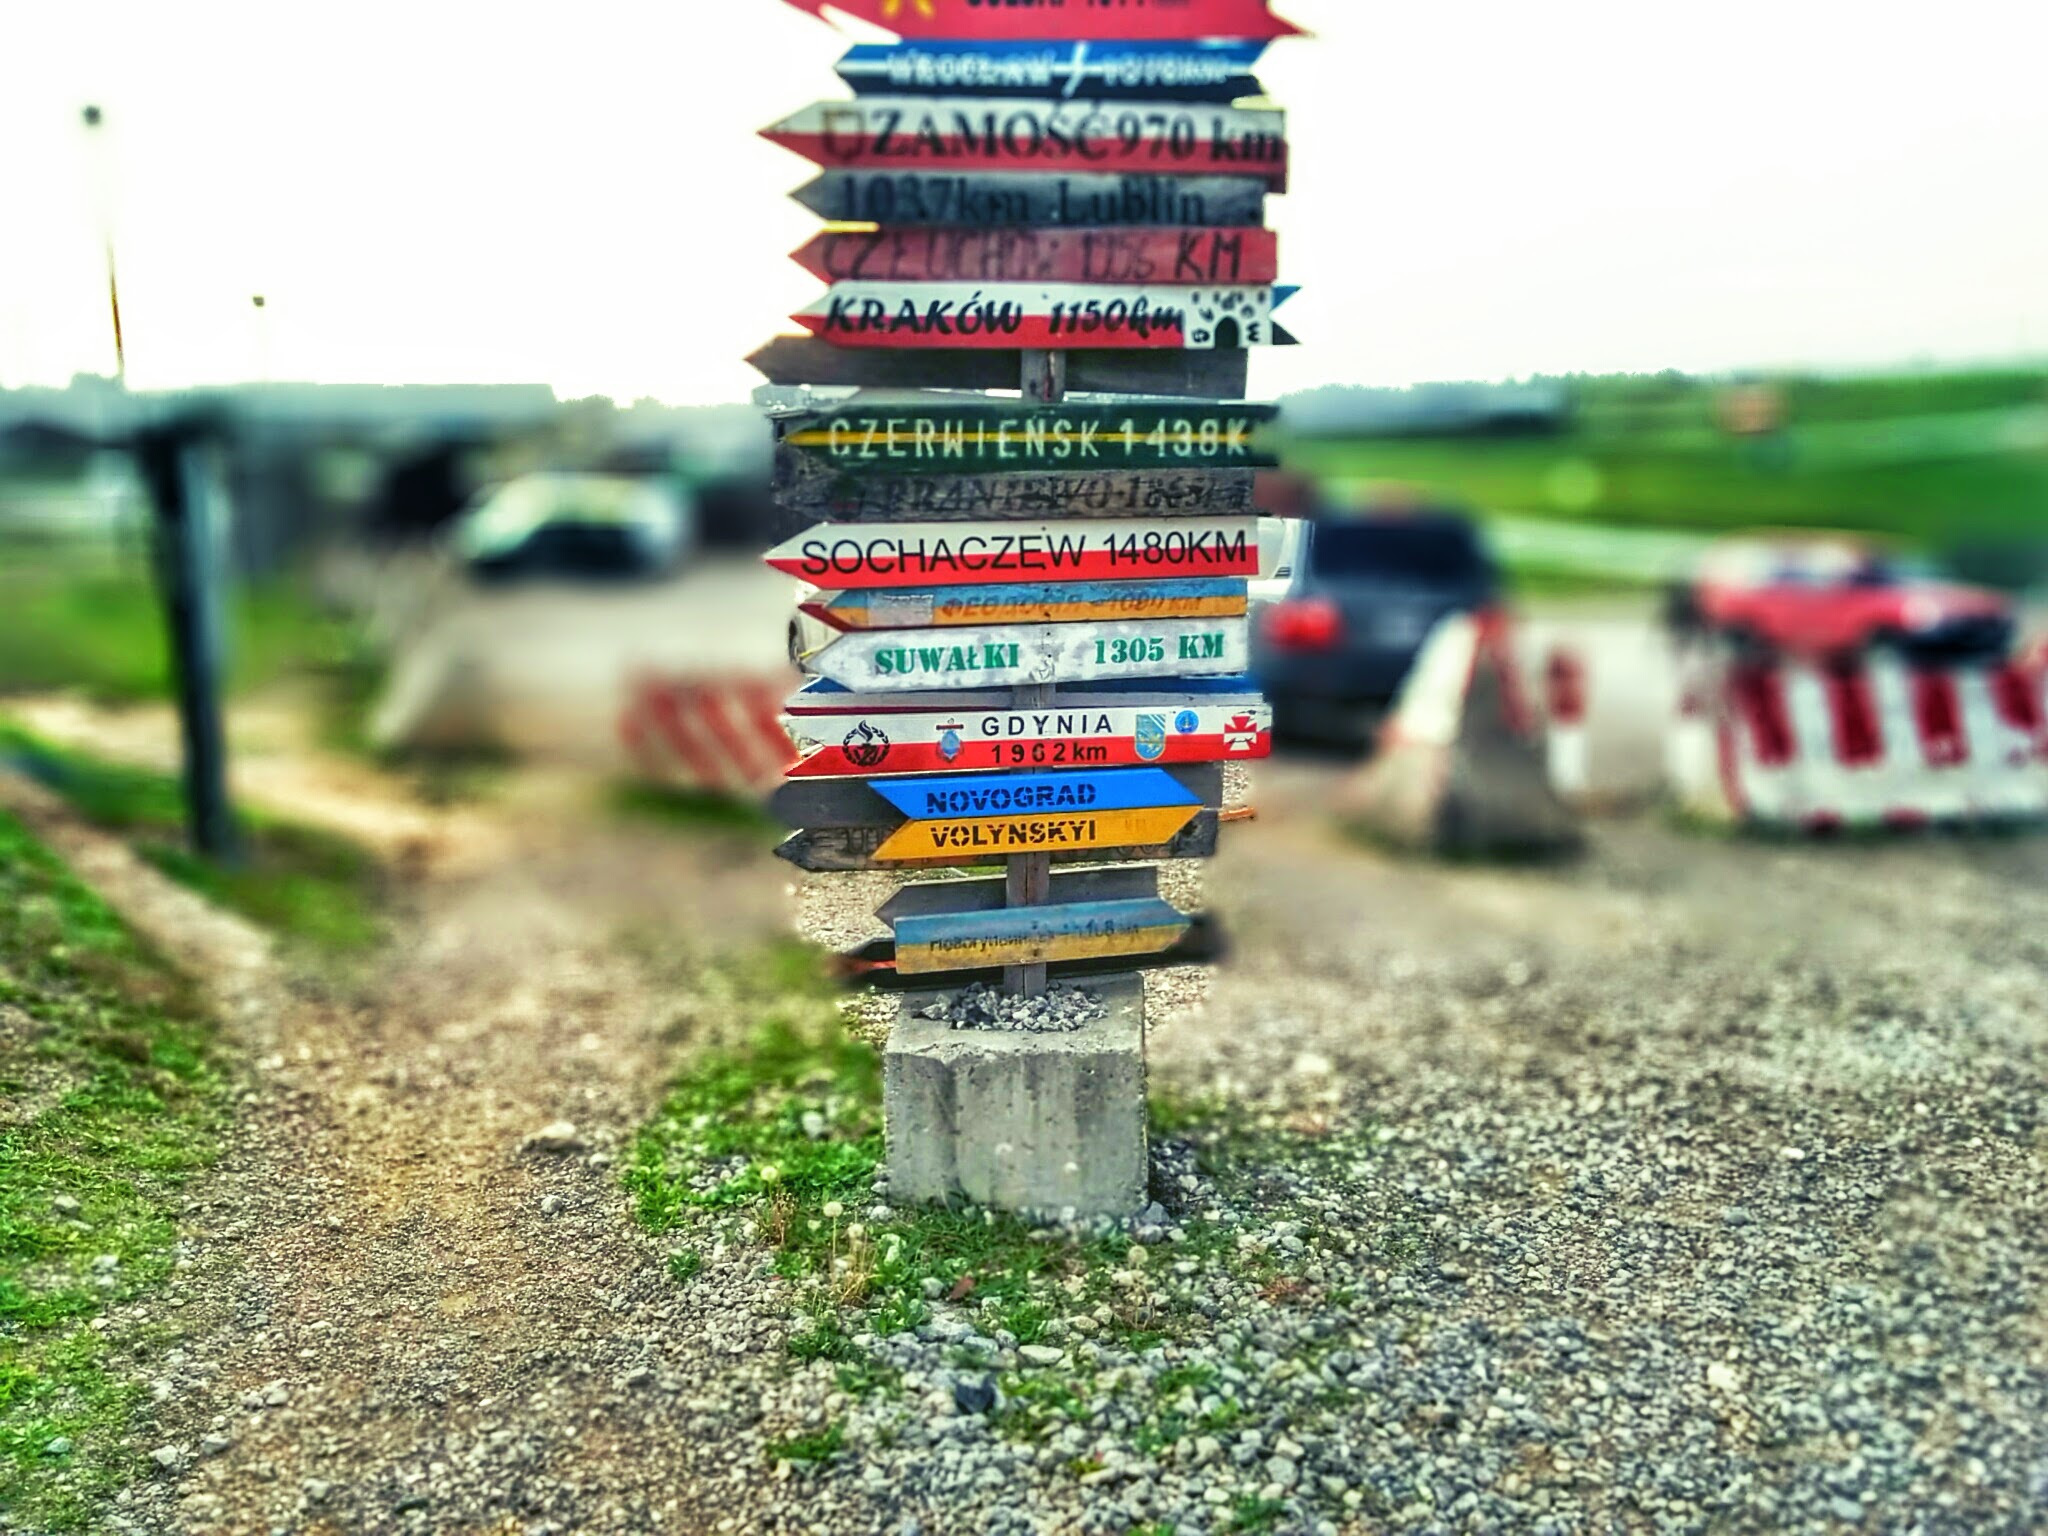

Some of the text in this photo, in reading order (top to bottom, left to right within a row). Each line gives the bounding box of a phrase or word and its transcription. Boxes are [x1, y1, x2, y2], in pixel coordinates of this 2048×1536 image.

[1116, 111, 1197, 161] 970
[1209, 117, 1285, 162] km
[1056, 174, 1206, 224] Lublin
[1174, 229, 1243, 279] KM
[825, 290, 1022, 334] KRAKÓW
[1048, 296, 1186, 338] 1150km
[801, 530, 1247, 575] SOCHACZEW 1480KM
[874, 633, 1225, 675] SUWAŁKI 1305 KM
[981, 714, 1112, 736] GDYNIA
[926, 784, 1096, 814] NOVOGRAD
[930, 819, 1095, 848] VOLYNSKYI
